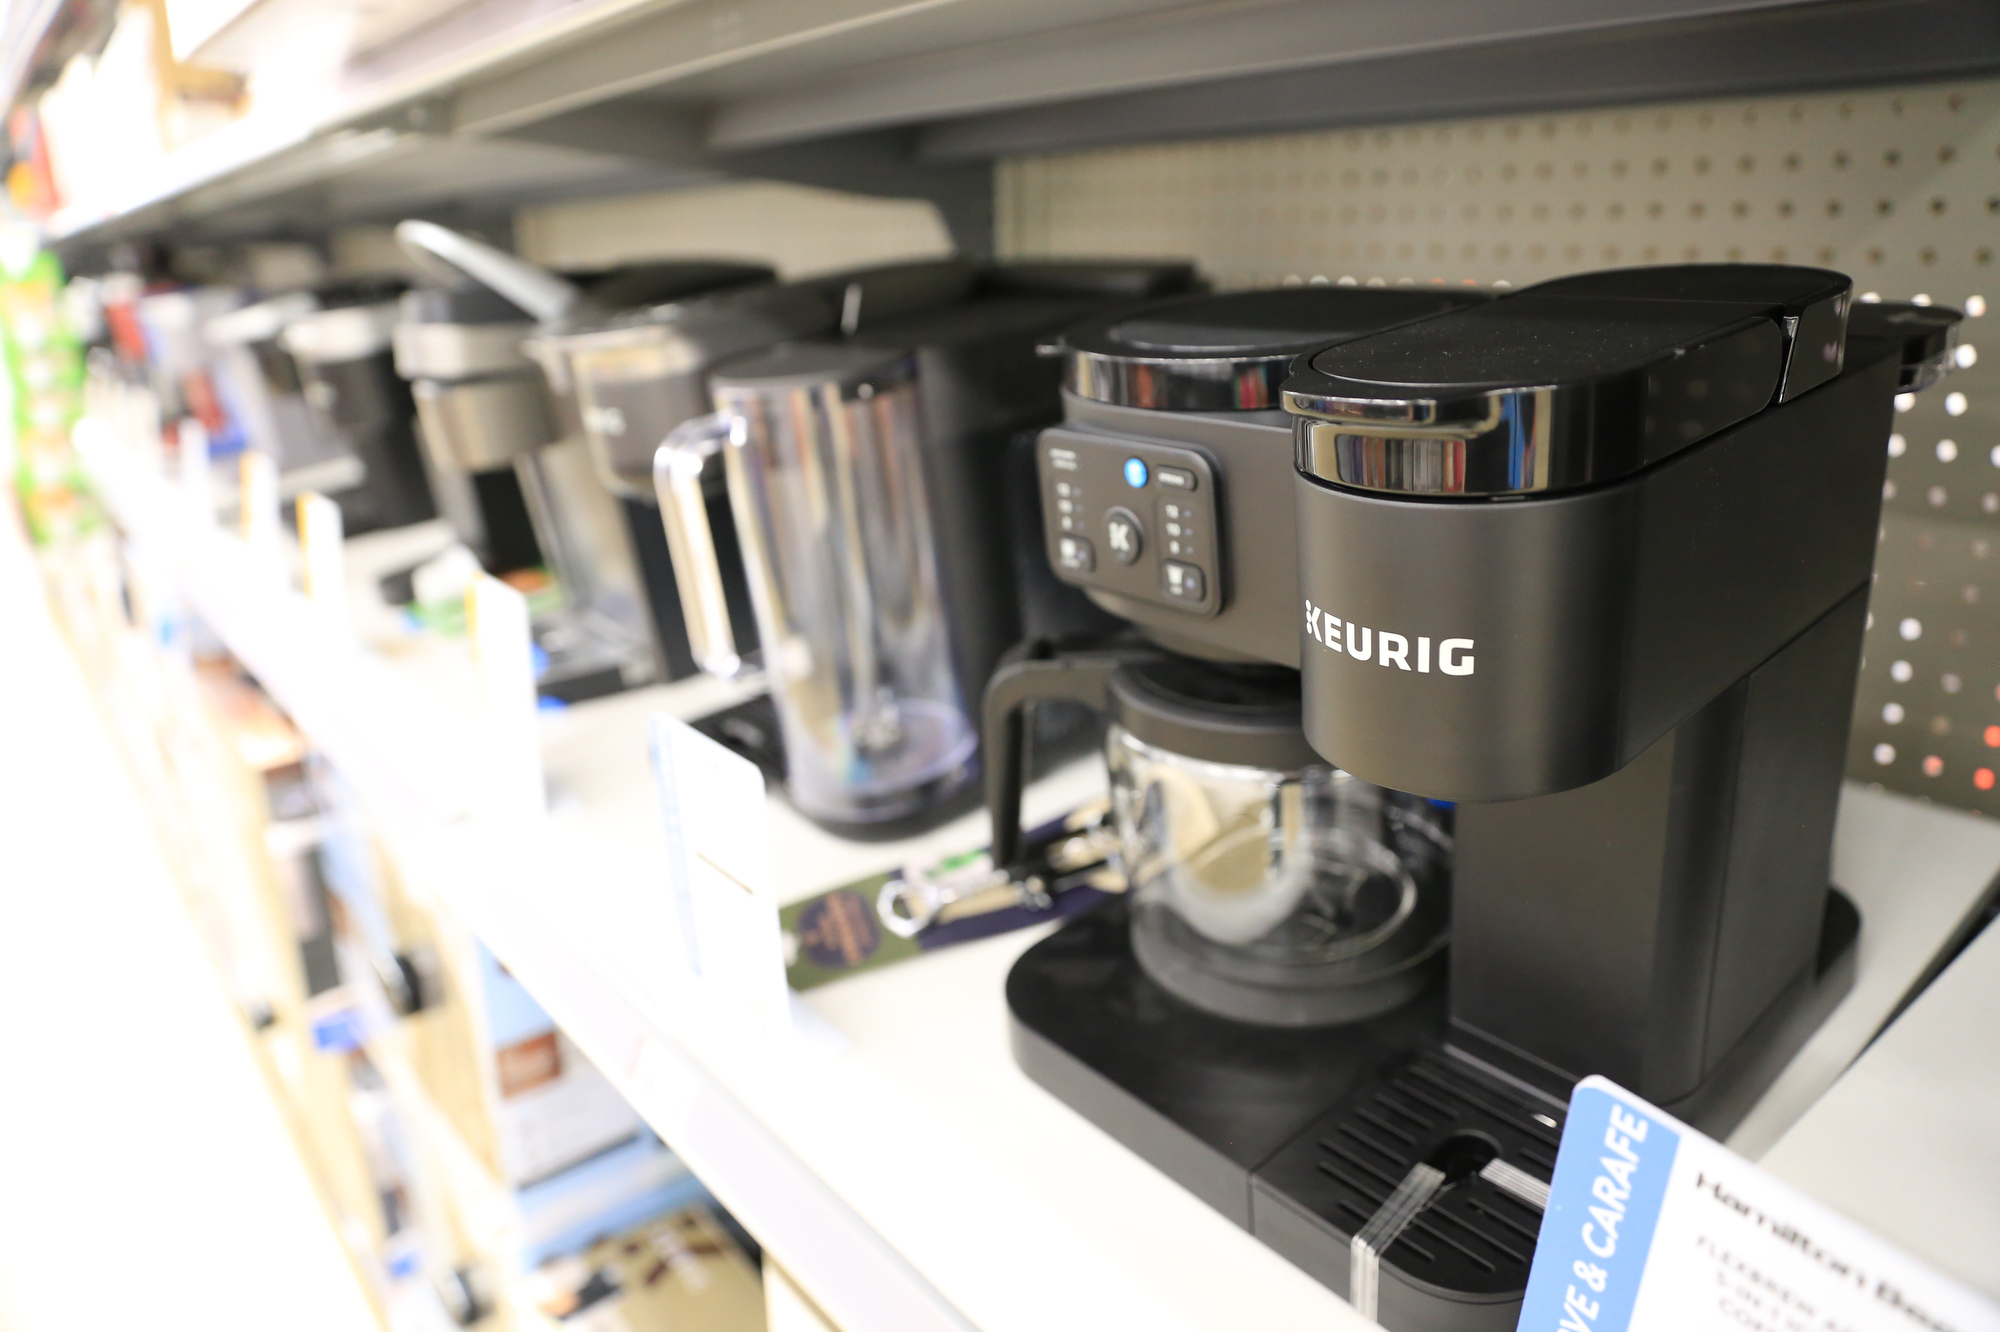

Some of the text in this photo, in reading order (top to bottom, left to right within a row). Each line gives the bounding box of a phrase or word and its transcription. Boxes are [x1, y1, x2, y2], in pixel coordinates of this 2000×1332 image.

[1305, 599, 1475, 676] KEURIG
[1556, 1104, 1649, 1332] VE & CARAFE
[1696, 1171, 1866, 1290] Hamilton
